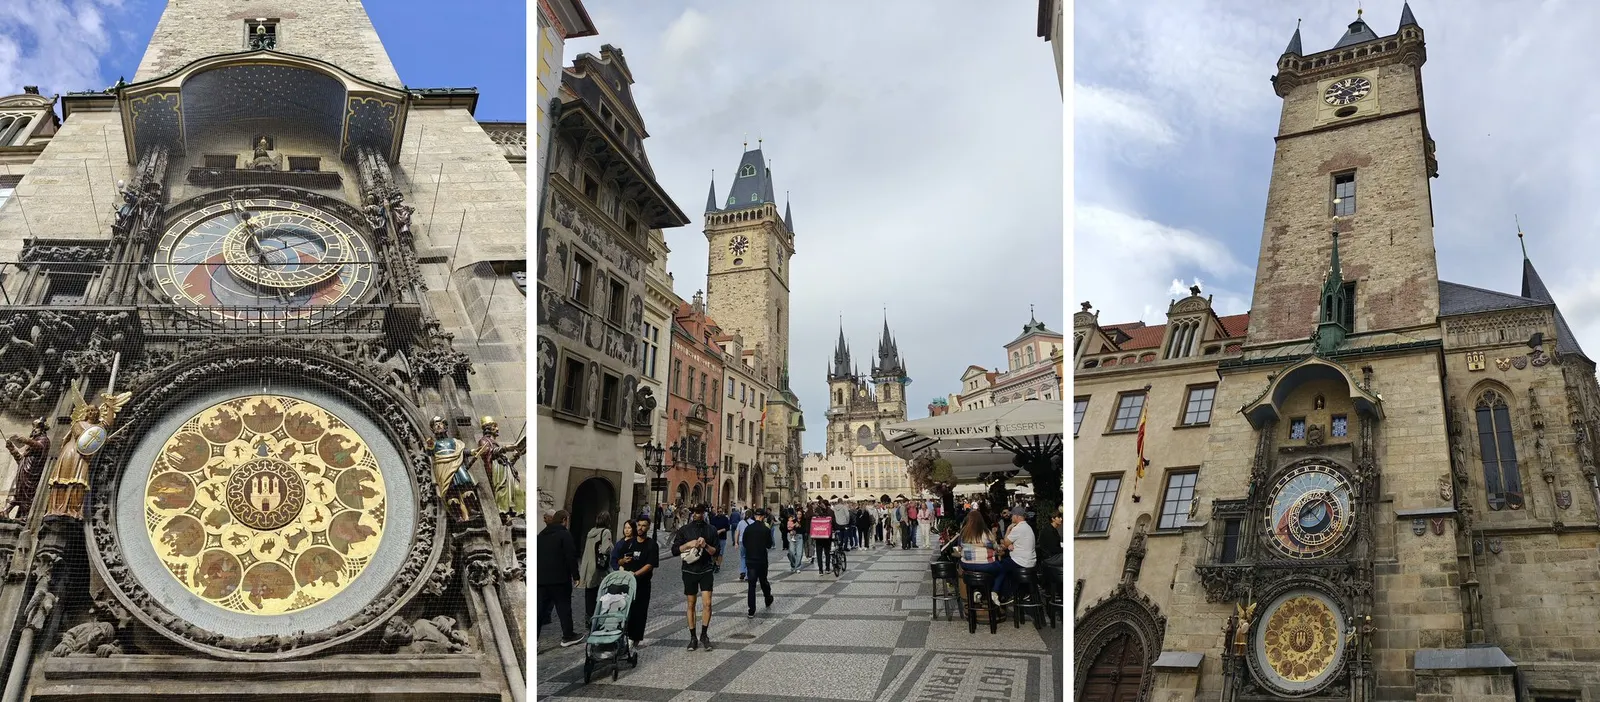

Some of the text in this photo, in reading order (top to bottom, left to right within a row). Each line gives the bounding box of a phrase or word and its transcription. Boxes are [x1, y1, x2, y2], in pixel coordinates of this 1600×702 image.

[933, 425, 991, 436] BREAKFAST
[1000, 421, 1046, 433] DESSERTS
[915, 667, 967, 702] PRIN
